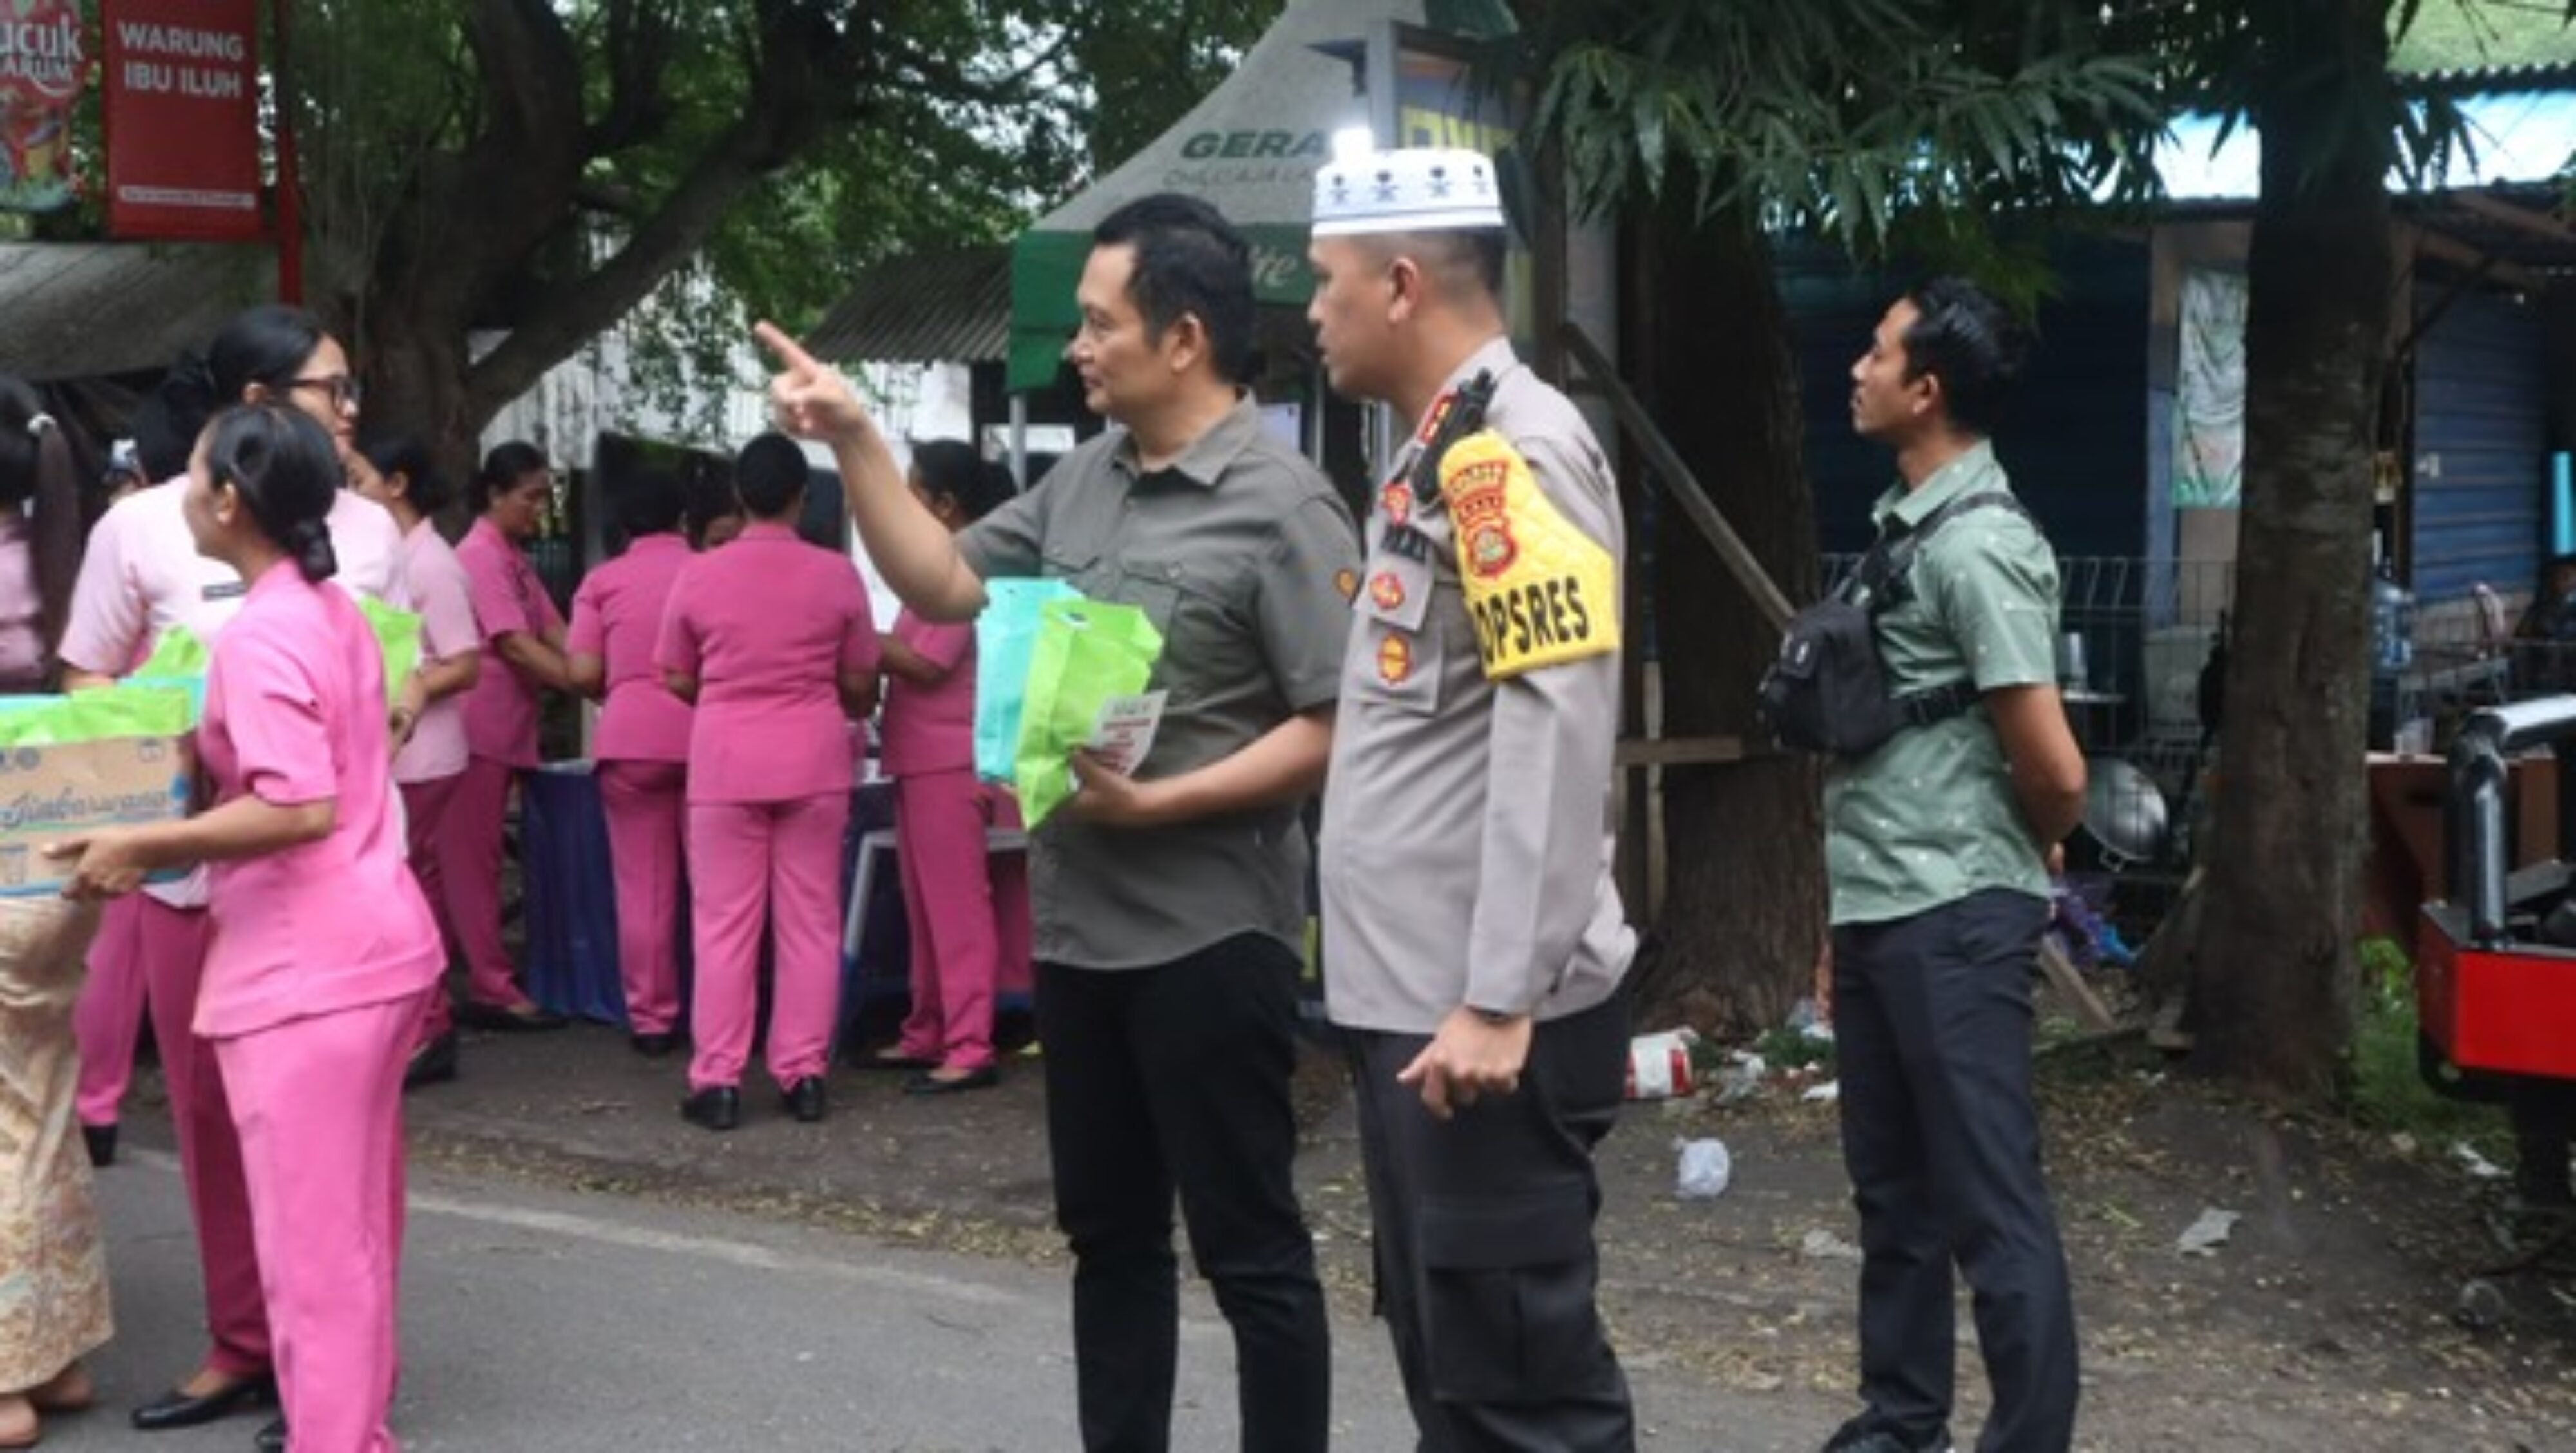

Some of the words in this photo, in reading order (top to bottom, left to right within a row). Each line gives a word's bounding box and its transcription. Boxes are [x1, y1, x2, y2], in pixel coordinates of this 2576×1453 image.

[0, 13, 84, 61] ucuk
[118, 21, 244, 61] WARUNG
[124, 61, 172, 91] IBU
[181, 68, 242, 98] ILUH
[1181, 131, 1327, 158] GERA
